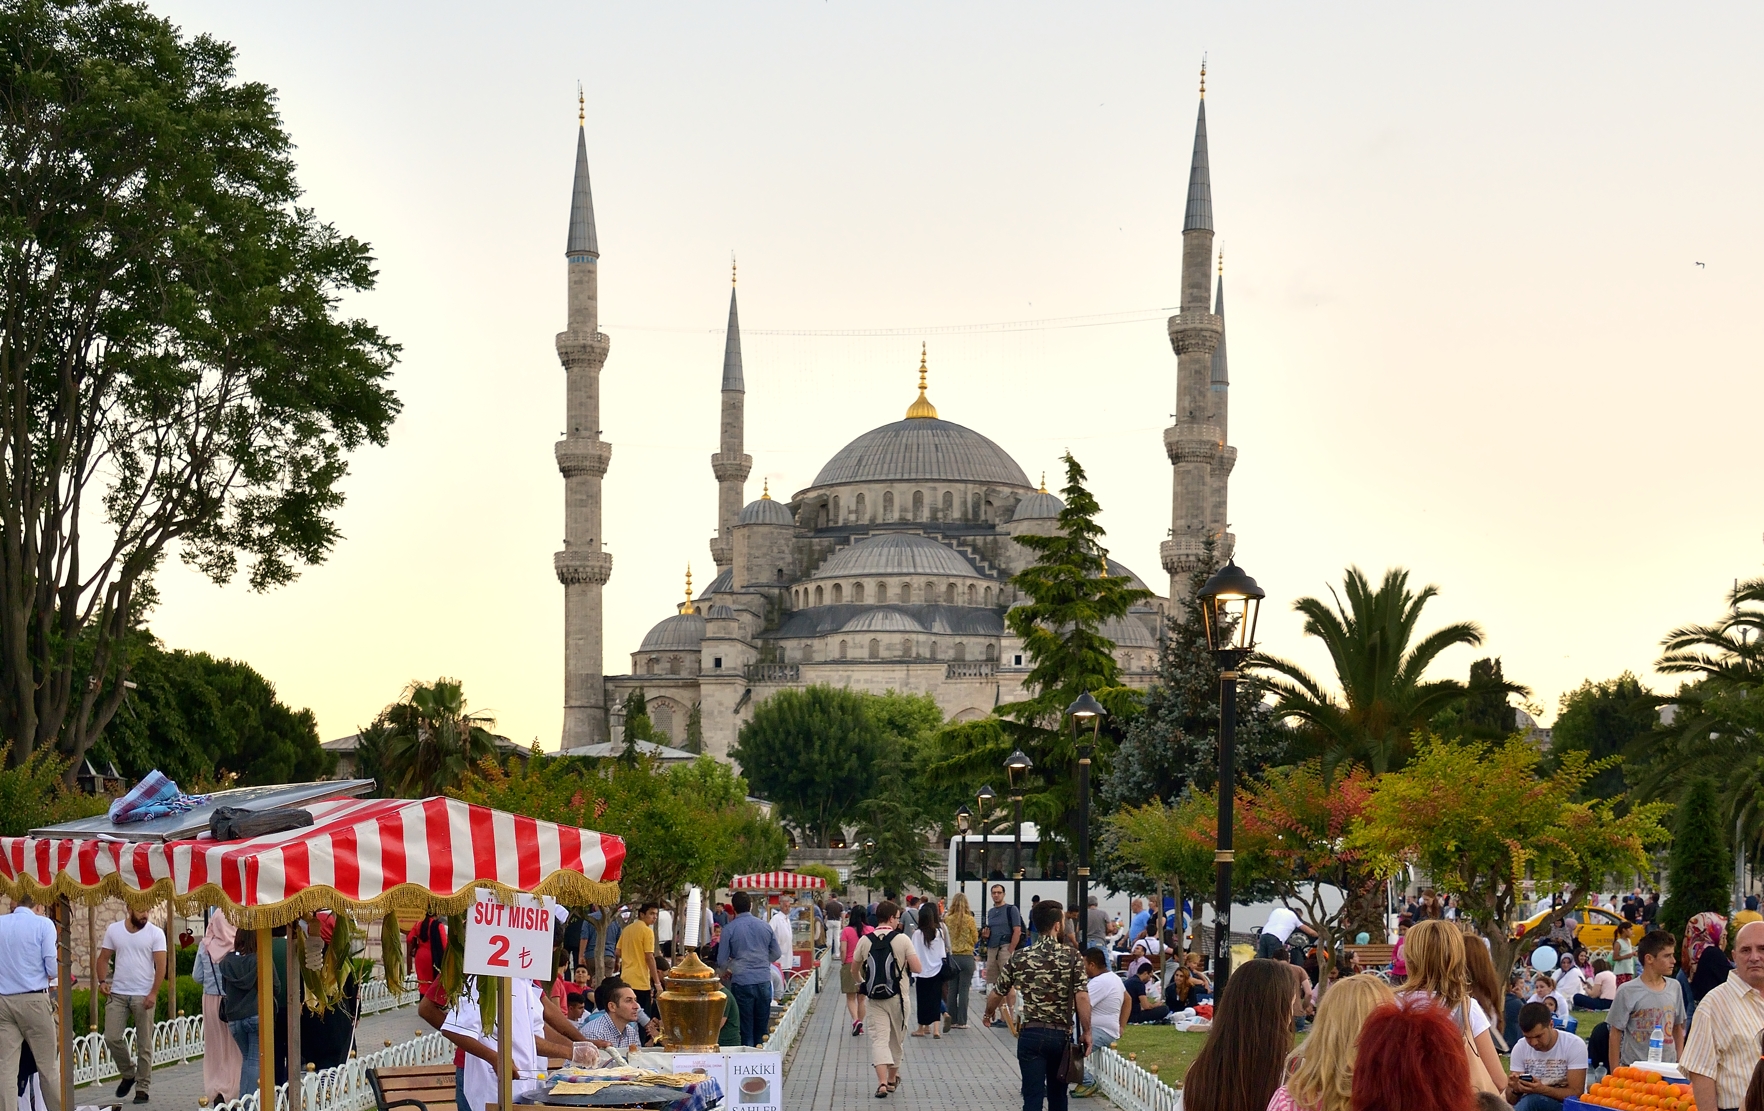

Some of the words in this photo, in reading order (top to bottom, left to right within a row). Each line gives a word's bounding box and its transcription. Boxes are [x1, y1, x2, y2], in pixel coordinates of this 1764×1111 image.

[474, 898, 505, 927] SÜT
[508, 906, 549, 932] MISIR
[487, 935, 510, 968] 2
[733, 1063, 776, 1075] HAKİKİ
